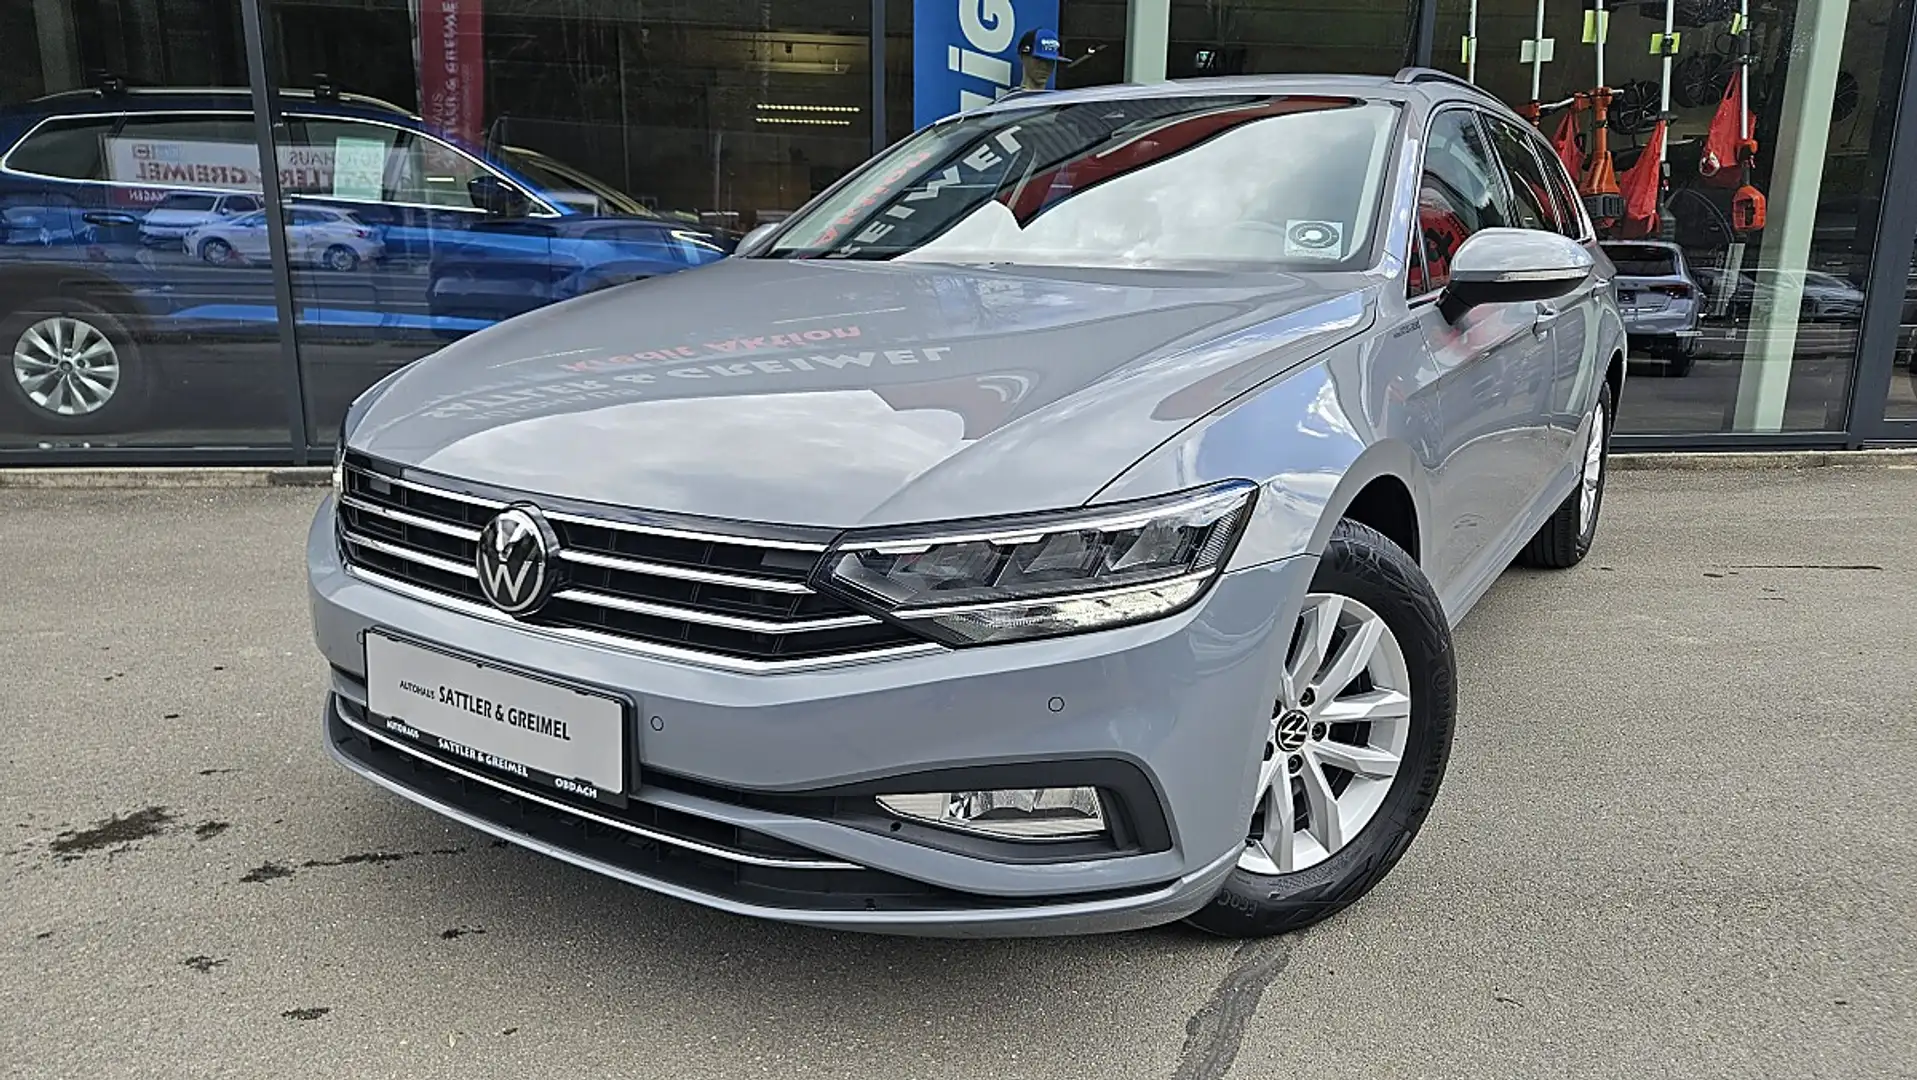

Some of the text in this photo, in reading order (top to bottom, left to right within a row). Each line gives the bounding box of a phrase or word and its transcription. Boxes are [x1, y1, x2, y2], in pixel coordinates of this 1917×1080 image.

[438, 685, 492, 718] SATTLER
[495, 704, 505, 722] &
[508, 708, 571, 741] GREIMEL
[438, 738, 529, 778] SATTLER & GREIMEL
[554, 777, 598, 799] OBDACH
